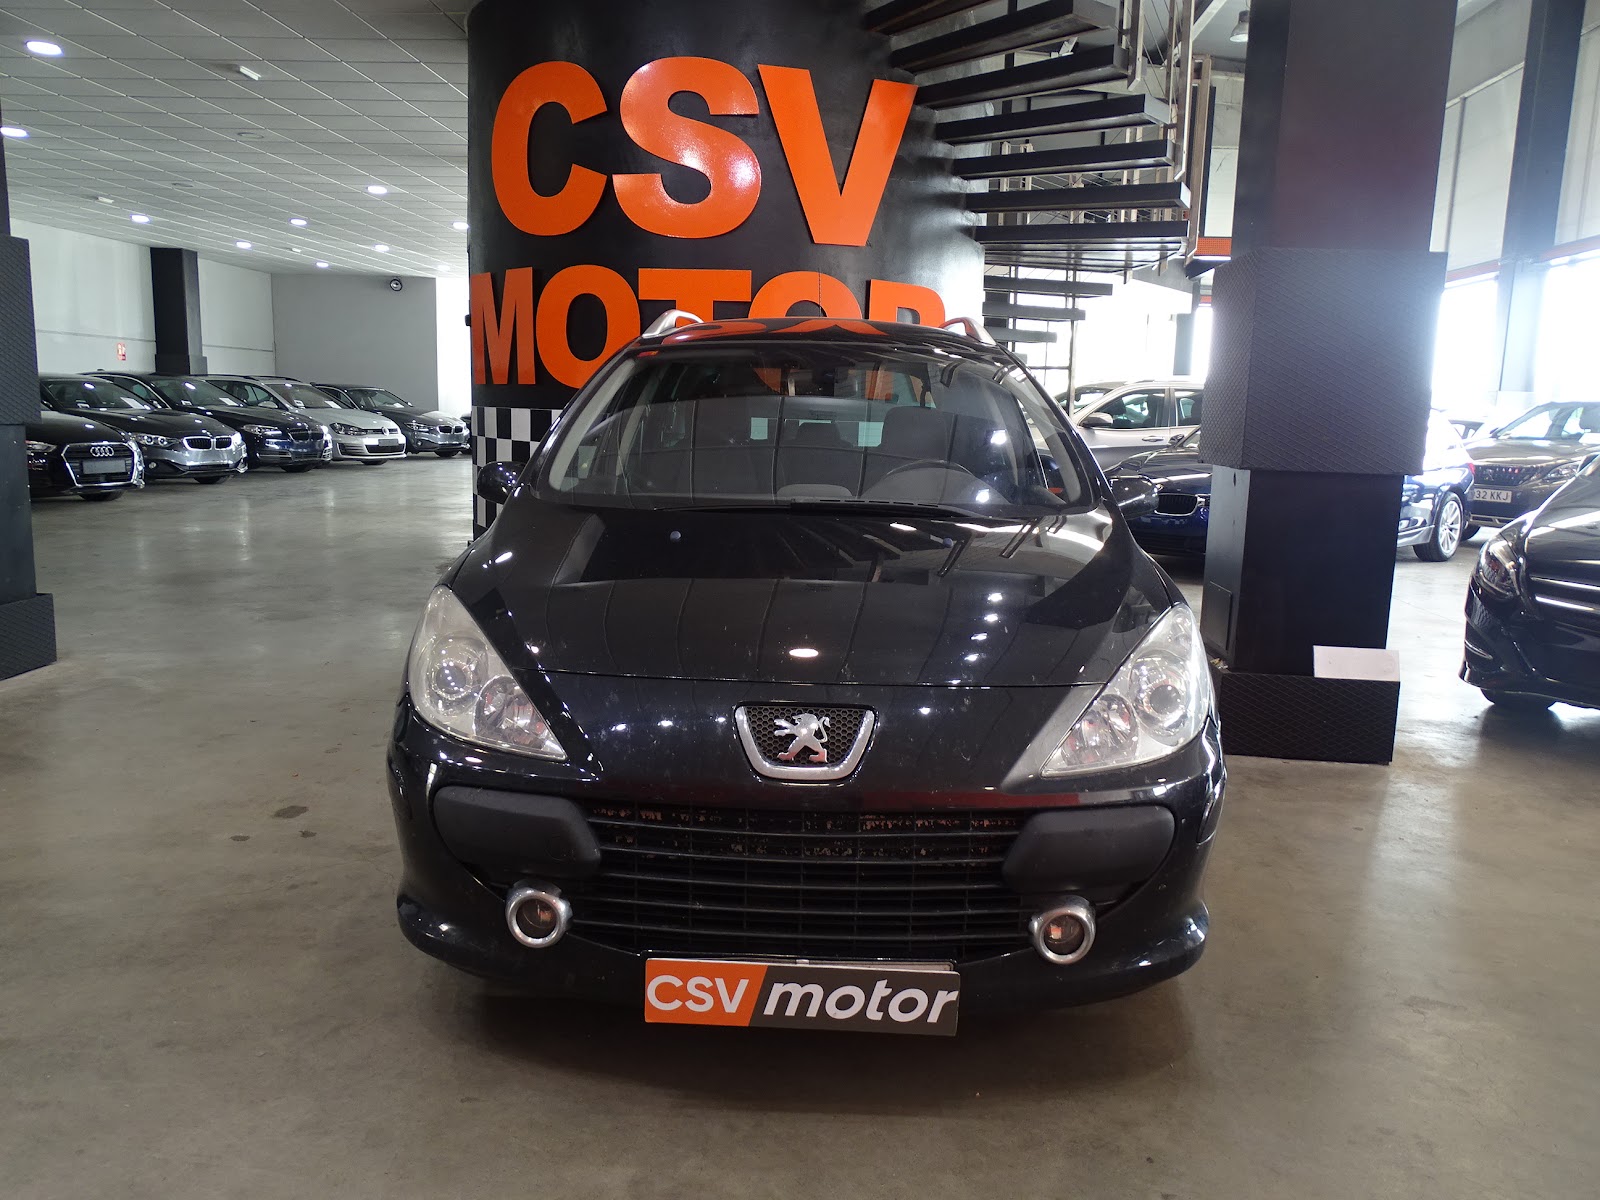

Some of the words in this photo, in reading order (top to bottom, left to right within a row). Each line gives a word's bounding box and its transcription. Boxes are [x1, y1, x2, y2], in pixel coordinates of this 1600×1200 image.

[491, 56, 919, 247] CSV
[1472, 489, 1488, 500] 32
[1490, 490, 1509, 501] KKJ
[646, 974, 750, 1014] CSV
[763, 979, 959, 1023] motor
